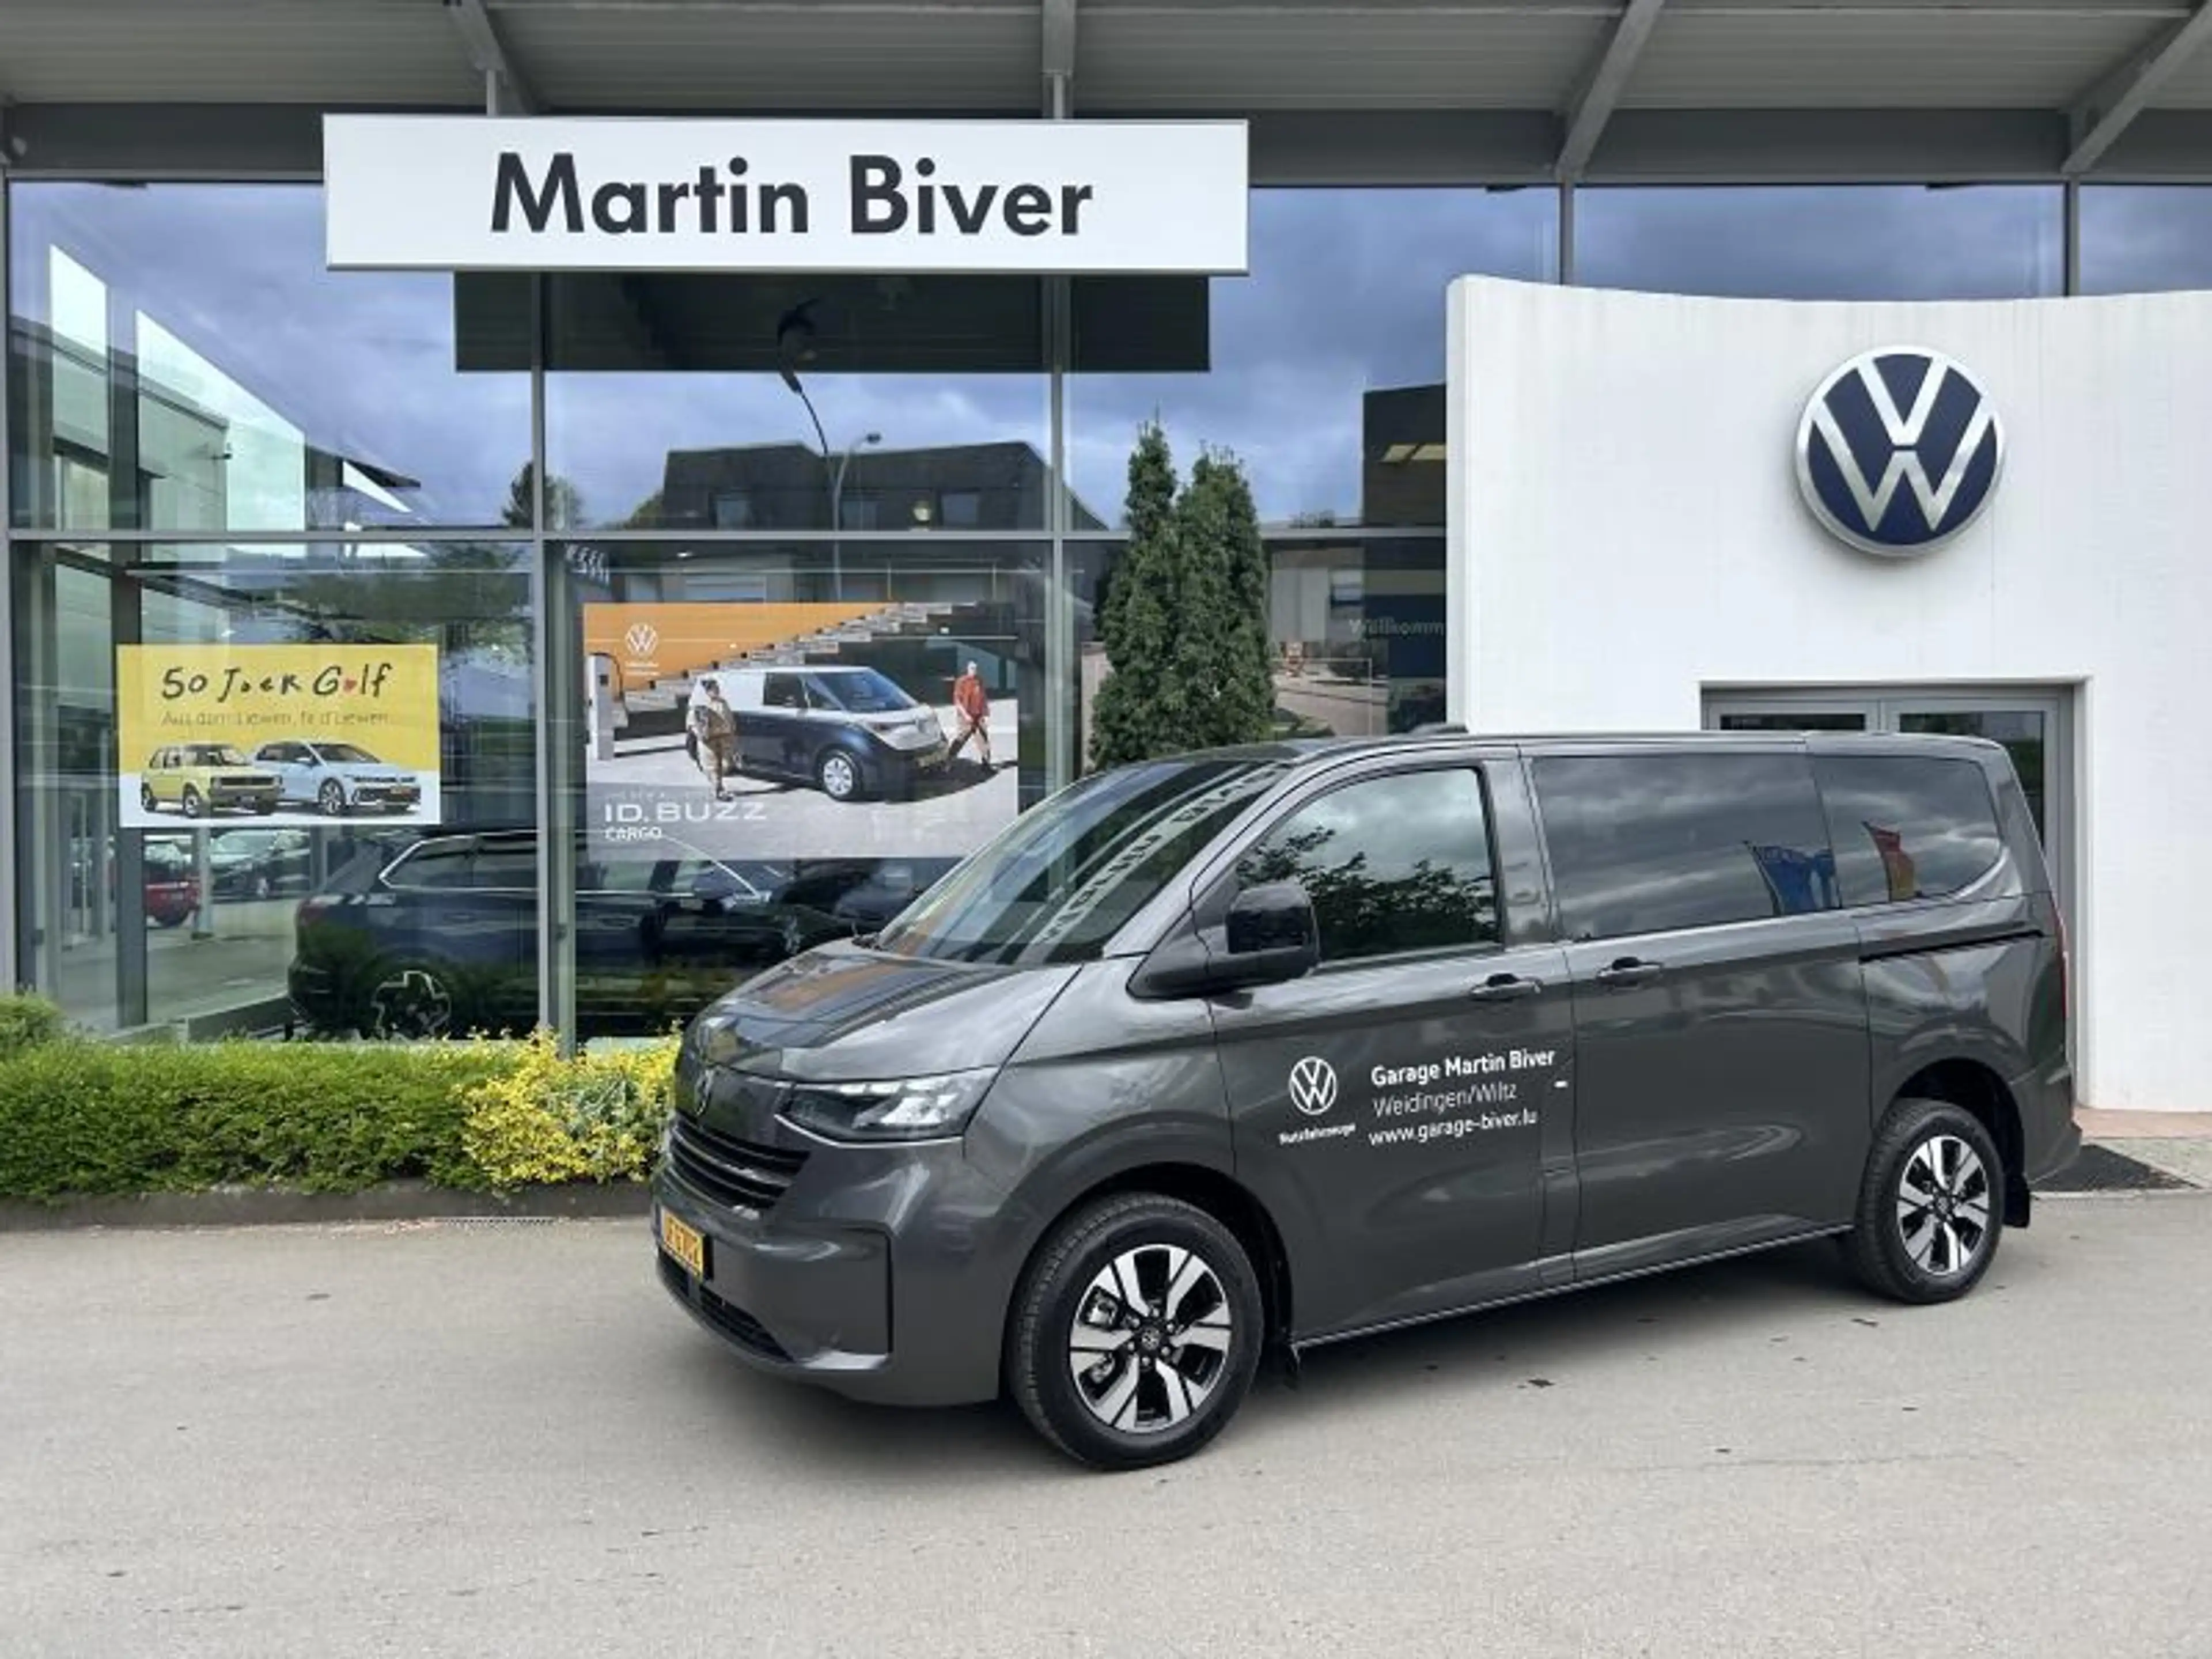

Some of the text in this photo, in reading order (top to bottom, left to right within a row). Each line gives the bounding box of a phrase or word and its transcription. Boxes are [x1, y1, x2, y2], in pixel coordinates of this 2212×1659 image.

[492, 153, 1092, 236] Martin Biver
[656, 801, 767, 822] BUZZ
[605, 825, 662, 841] CARGO
[1371, 1048, 1555, 1088] Garage Martin Biver
[1373, 1081, 1518, 1118] Weidingen/Wiltz
[1368, 1107, 1537, 1146] www.garage-biver.lu
